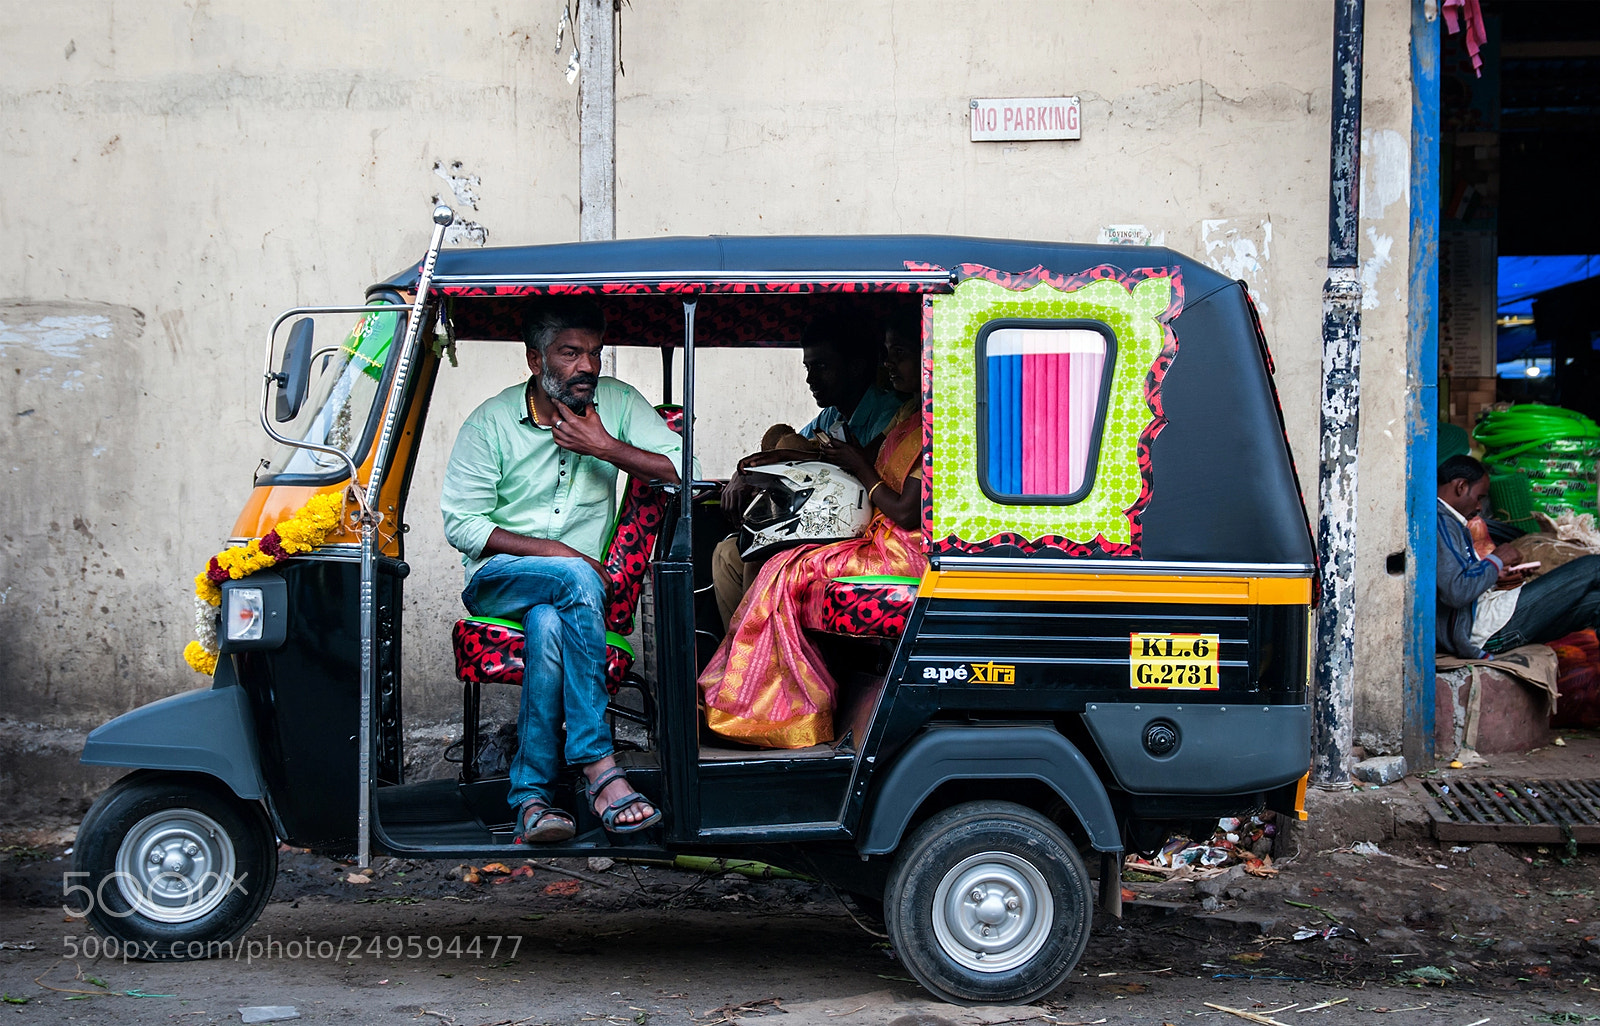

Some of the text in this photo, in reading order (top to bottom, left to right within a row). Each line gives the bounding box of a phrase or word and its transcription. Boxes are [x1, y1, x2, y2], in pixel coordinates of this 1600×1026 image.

[974, 105, 1078, 132] NO PARKING
[1140, 637, 1210, 658] KL.6
[1136, 663, 1214, 685] G.2731
